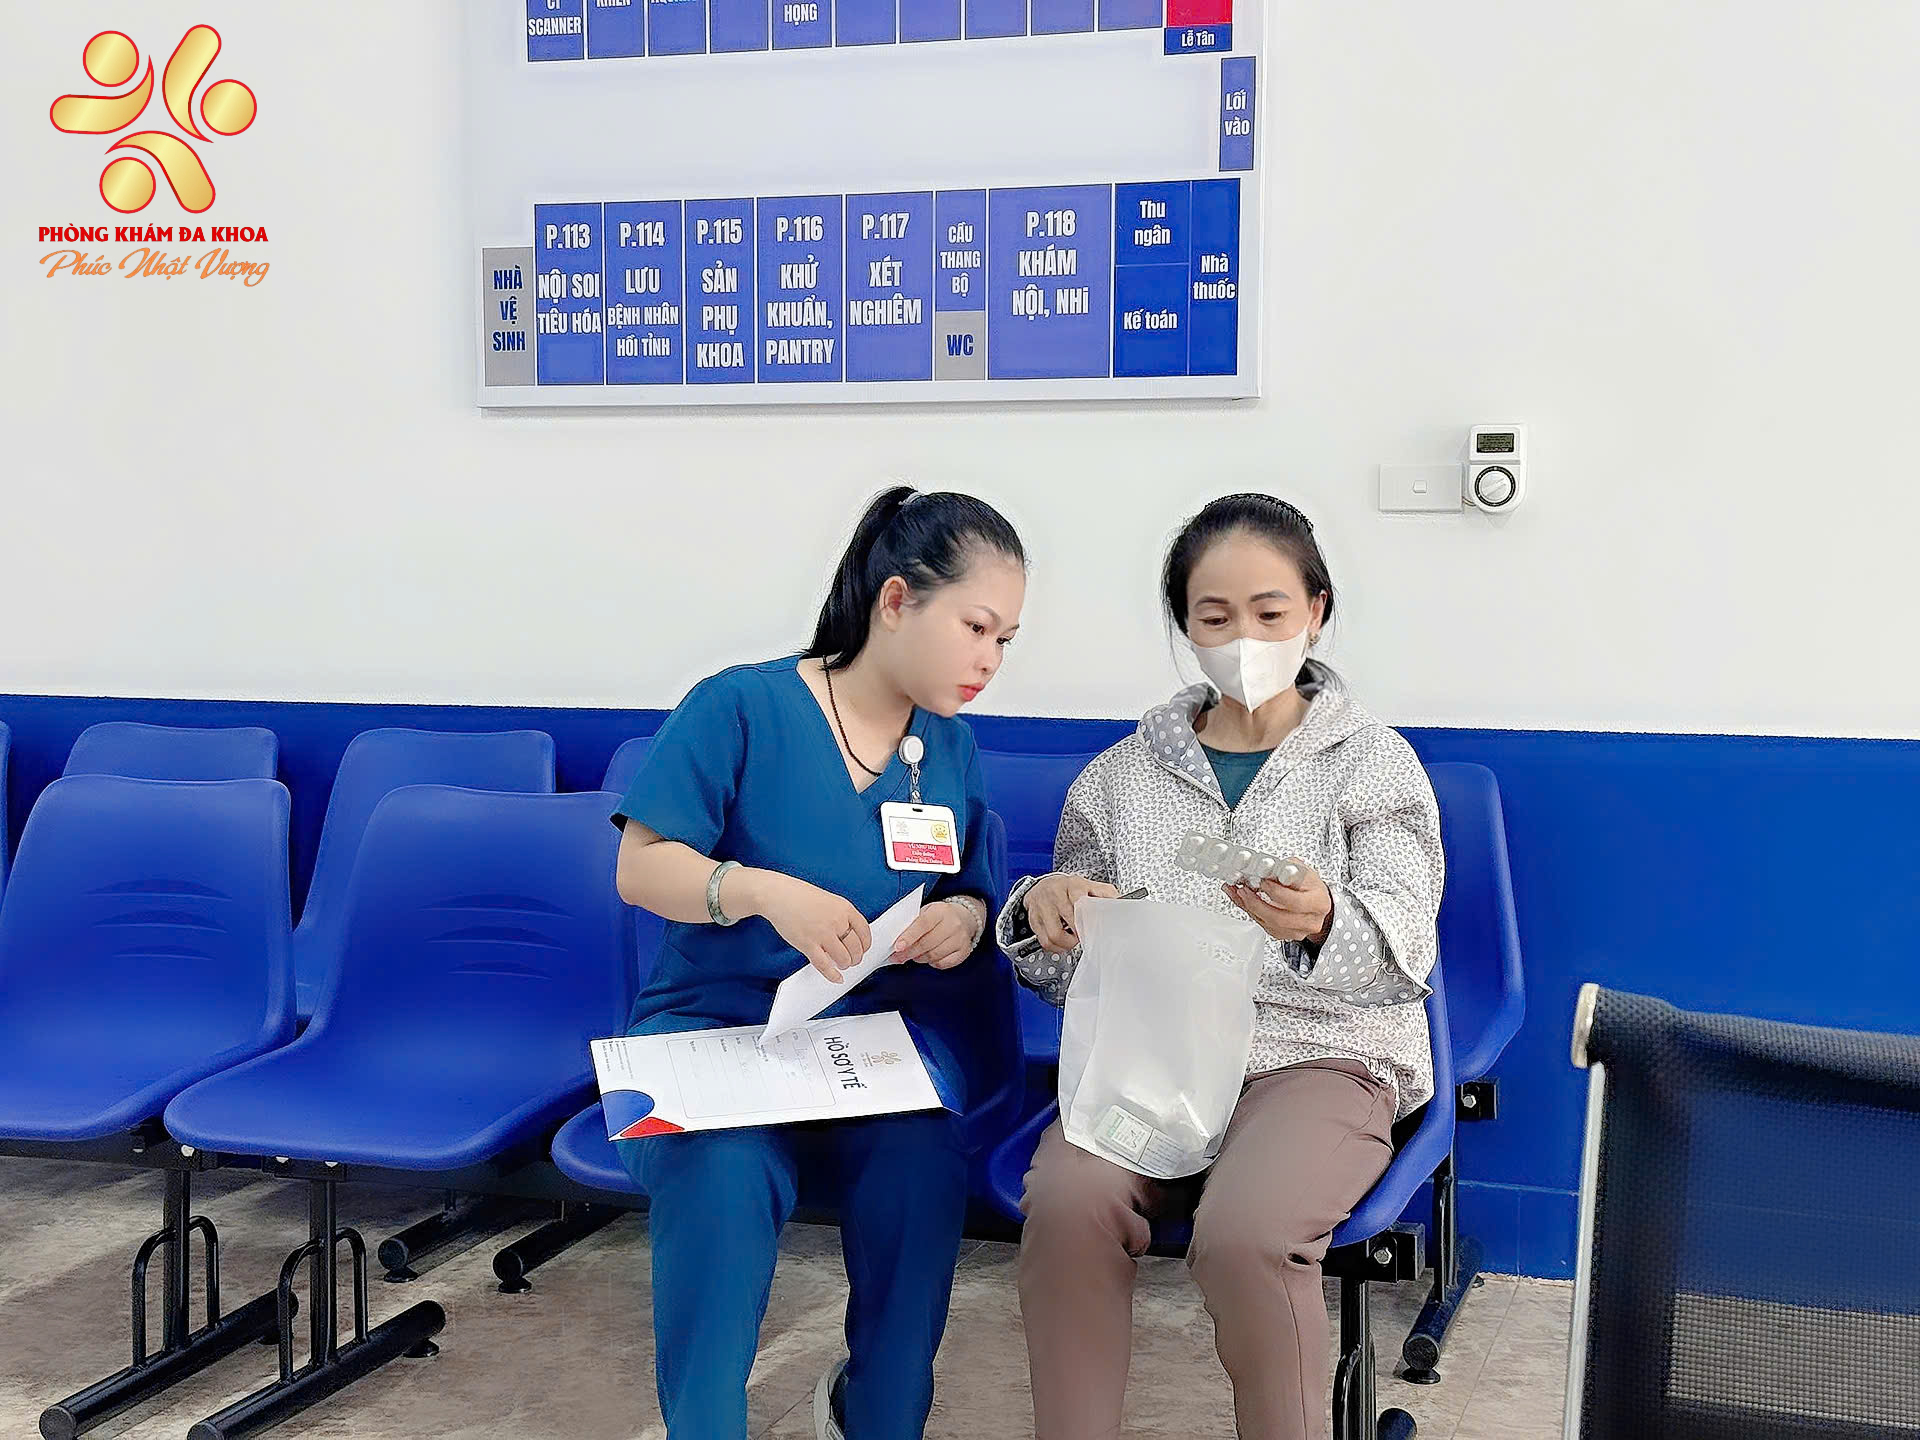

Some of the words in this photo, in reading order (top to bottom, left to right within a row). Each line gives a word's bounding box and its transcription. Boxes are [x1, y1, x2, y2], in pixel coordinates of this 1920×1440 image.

[528, 15, 583, 36] SCANNER
[784, 3, 818, 26] HỌNG
[1181, 29, 1194, 47] Lễ
[1194, 30, 1215, 46] Tân
[1225, 88, 1248, 111] Lối
[1224, 116, 1252, 137] vào
[1139, 200, 1166, 219] Thu
[546, 223, 591, 249] P.113
[620, 221, 665, 247] P.114
[697, 218, 743, 245] P.115
[776, 215, 823, 242] P.116
[862, 212, 910, 240] P.117
[948, 221, 973, 244] CẦU
[1026, 209, 1076, 238] P.118
[1134, 224, 1171, 247] ngân
[780, 254, 820, 289] KHỬ
[869, 255, 903, 287] XÉT
[939, 250, 981, 269] THANG
[1019, 243, 1077, 277] KHÁM
[1201, 252, 1229, 273] Nhà
[493, 264, 523, 290] NHÀ
[538, 268, 567, 304] NỘI
[571, 273, 600, 298] SOI
[625, 266, 660, 294] LƯU
[702, 260, 737, 293] SẢN
[952, 272, 969, 297] BỘ
[1192, 277, 1236, 300] thuốc
[499, 295, 518, 325] VỆ
[1012, 283, 1050, 321] NỘI,
[537, 307, 568, 334] TIÊU
[572, 307, 602, 334] HÓA
[607, 303, 641, 330] BỆNH
[644, 301, 679, 325] NHÂN
[702, 305, 738, 336] PHỤ
[1123, 309, 1148, 330] Kế
[1144, 309, 1178, 330] toán
[492, 330, 526, 352] SINH
[616, 334, 638, 357] HỒI
[641, 332, 670, 356] TỈNH
[766, 338, 835, 365] PANTRY
[946, 334, 974, 356] WC
[696, 342, 744, 368] KHOA
[824, 1036, 850, 1051] HỒ
[831, 1053, 854, 1066] SƠ
[838, 1067, 857, 1075] Y
[841, 1076, 868, 1089] TẾ
